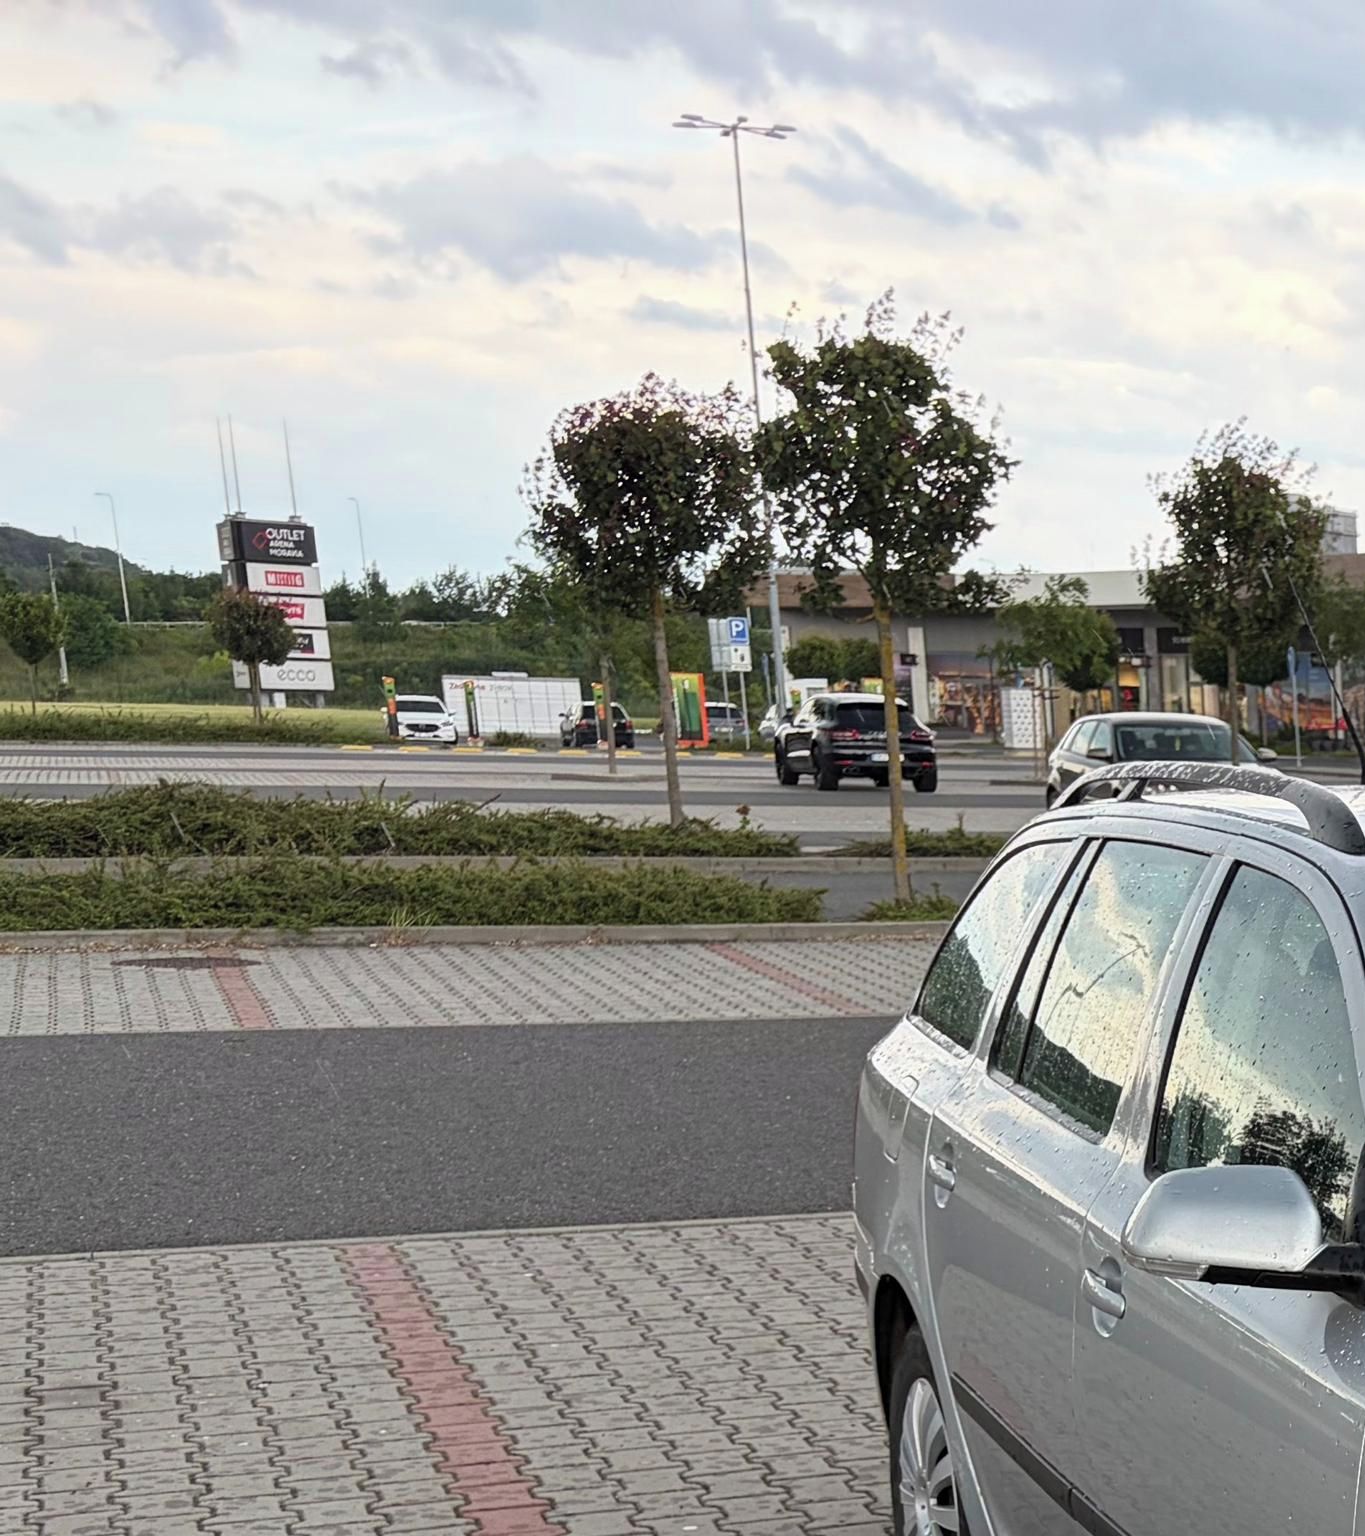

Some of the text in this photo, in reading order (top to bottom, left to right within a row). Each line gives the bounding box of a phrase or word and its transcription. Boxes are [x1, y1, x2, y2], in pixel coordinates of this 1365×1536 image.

[265, 527, 305, 541] OUTLET
[731, 620, 745, 637] P
[277, 669, 316, 682] ecco
